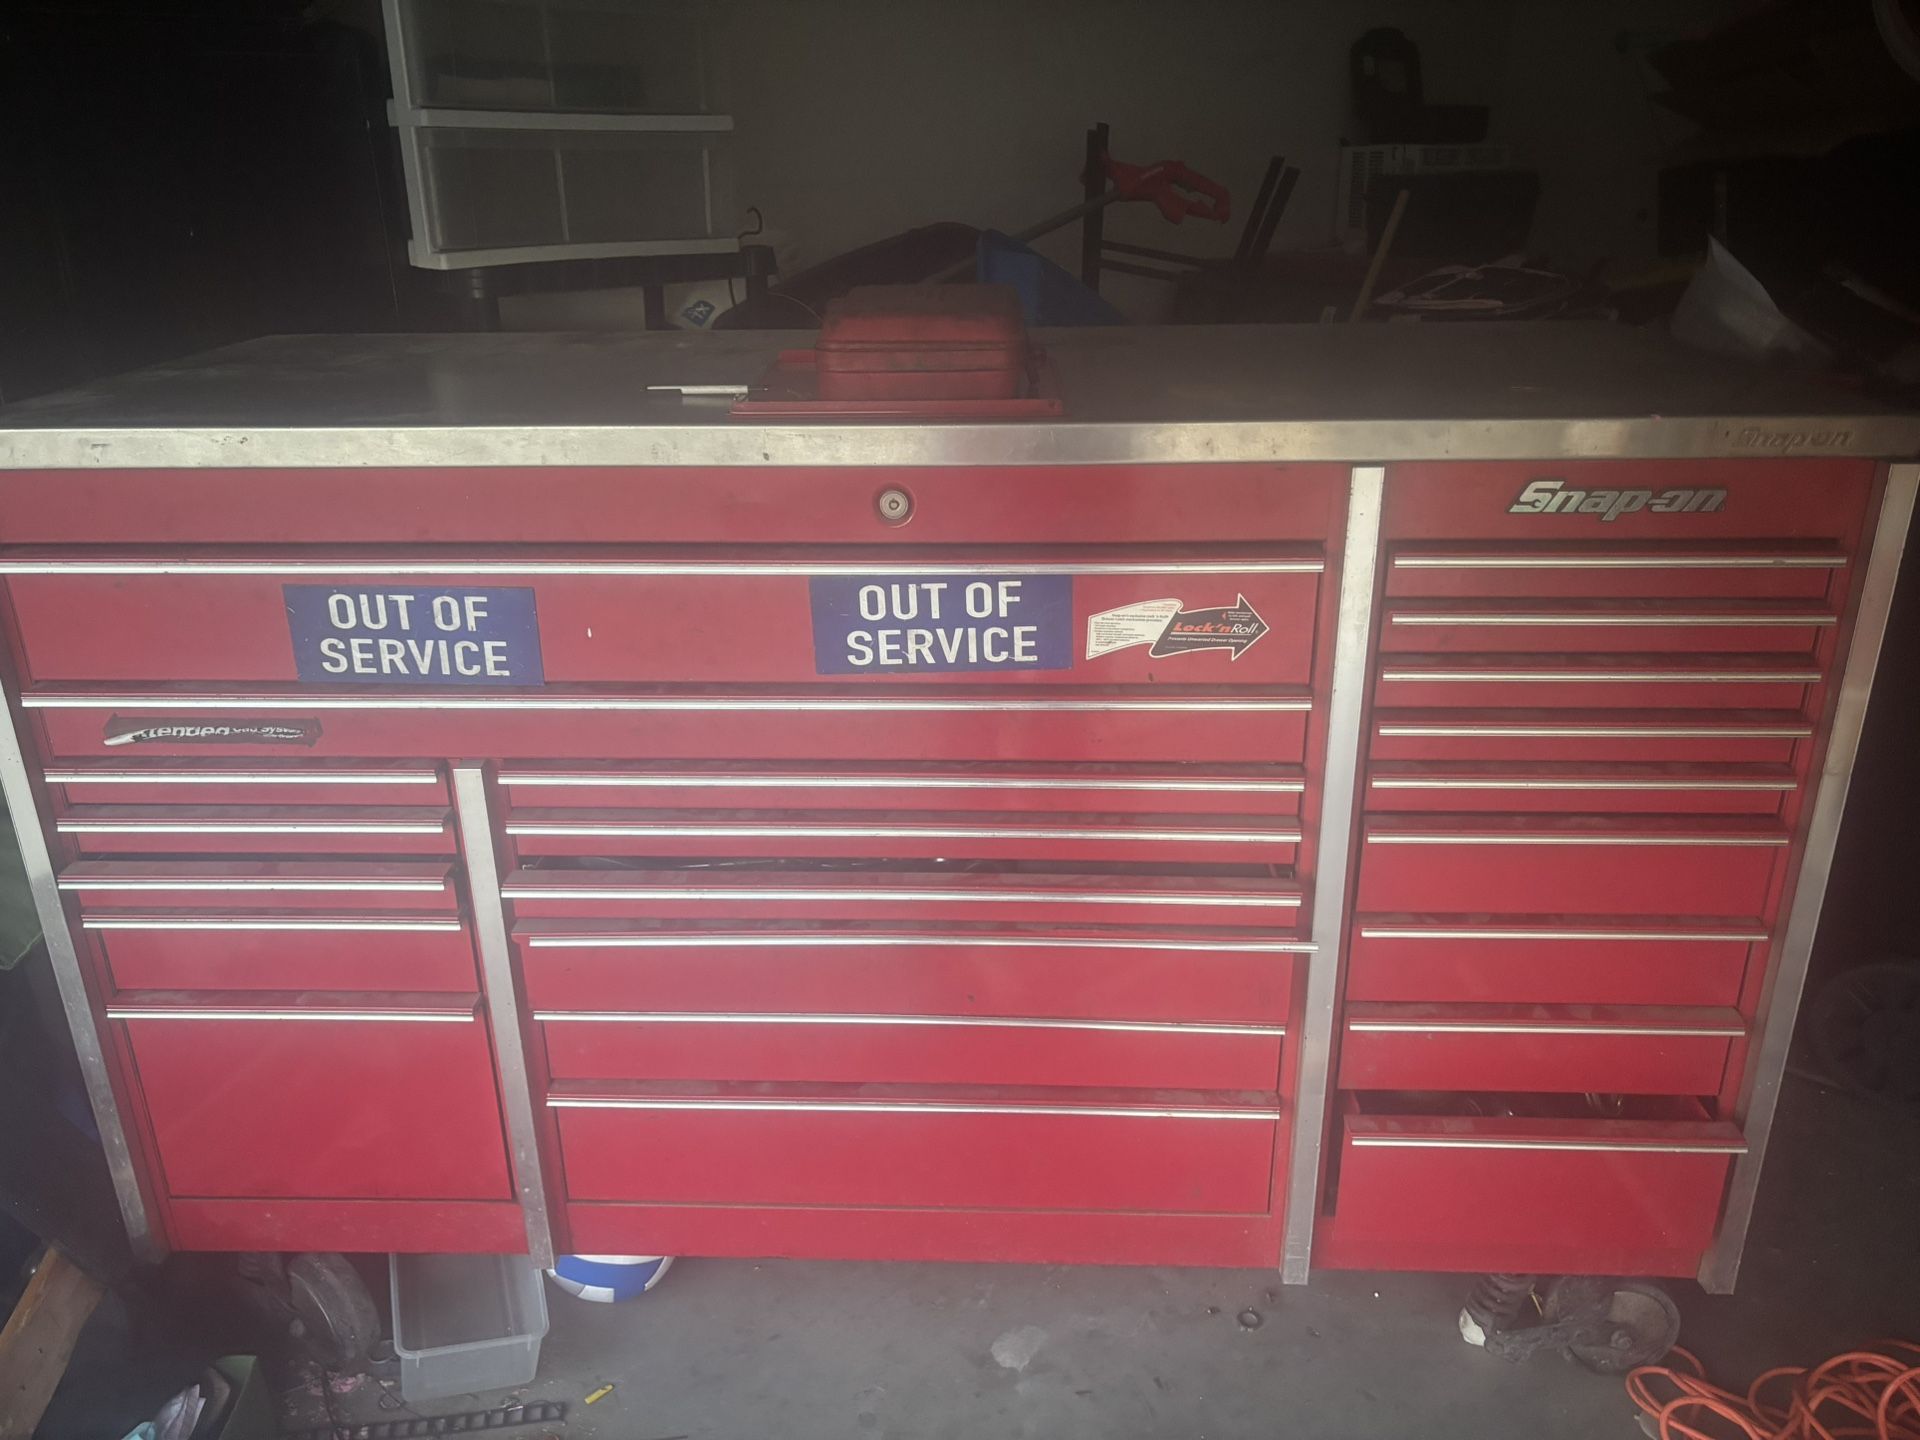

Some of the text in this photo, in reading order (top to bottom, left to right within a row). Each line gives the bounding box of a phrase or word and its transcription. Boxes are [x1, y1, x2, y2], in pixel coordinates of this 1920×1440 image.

[1509, 480, 1728, 522] Snap-on
[327, 593, 488, 632] OUT OF
[858, 580, 1022, 621] OUT OF
[319, 637, 511, 677] SERVICE
[846, 625, 1038, 666] SERVICE
